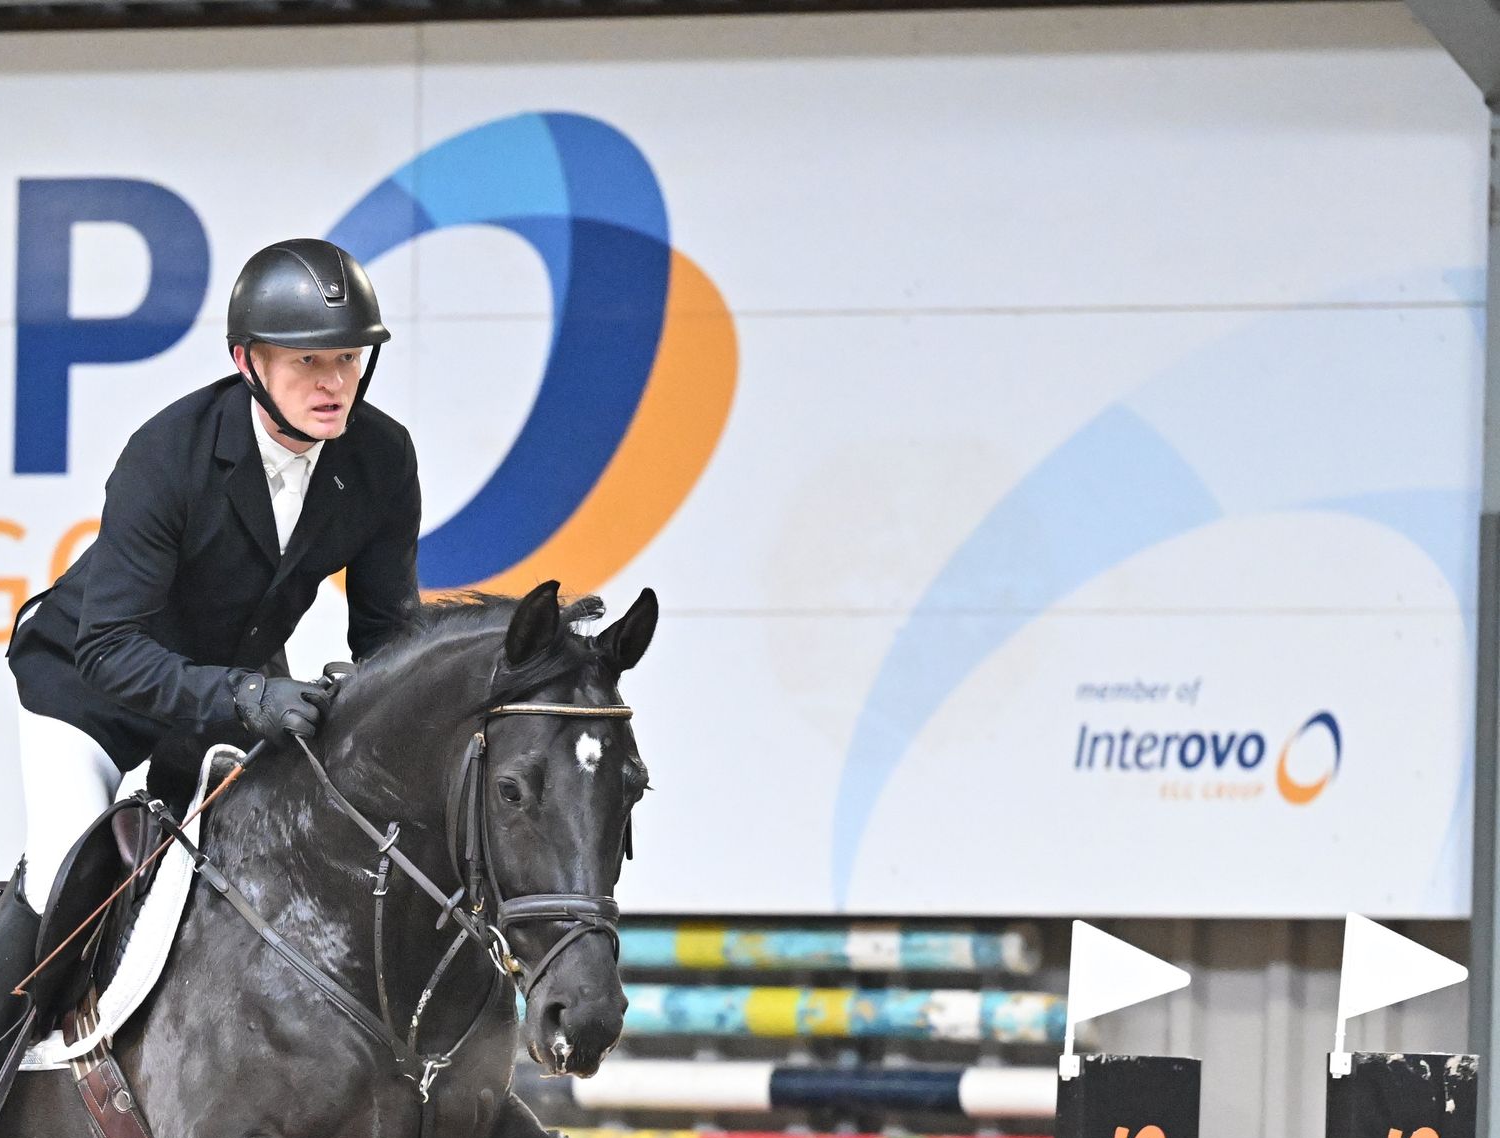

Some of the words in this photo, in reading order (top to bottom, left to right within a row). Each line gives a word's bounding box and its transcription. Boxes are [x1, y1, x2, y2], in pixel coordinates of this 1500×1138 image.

[1076, 678, 1171, 702] member
[1175, 677, 1203, 705] of
[1075, 723, 1266, 771] Interovo
